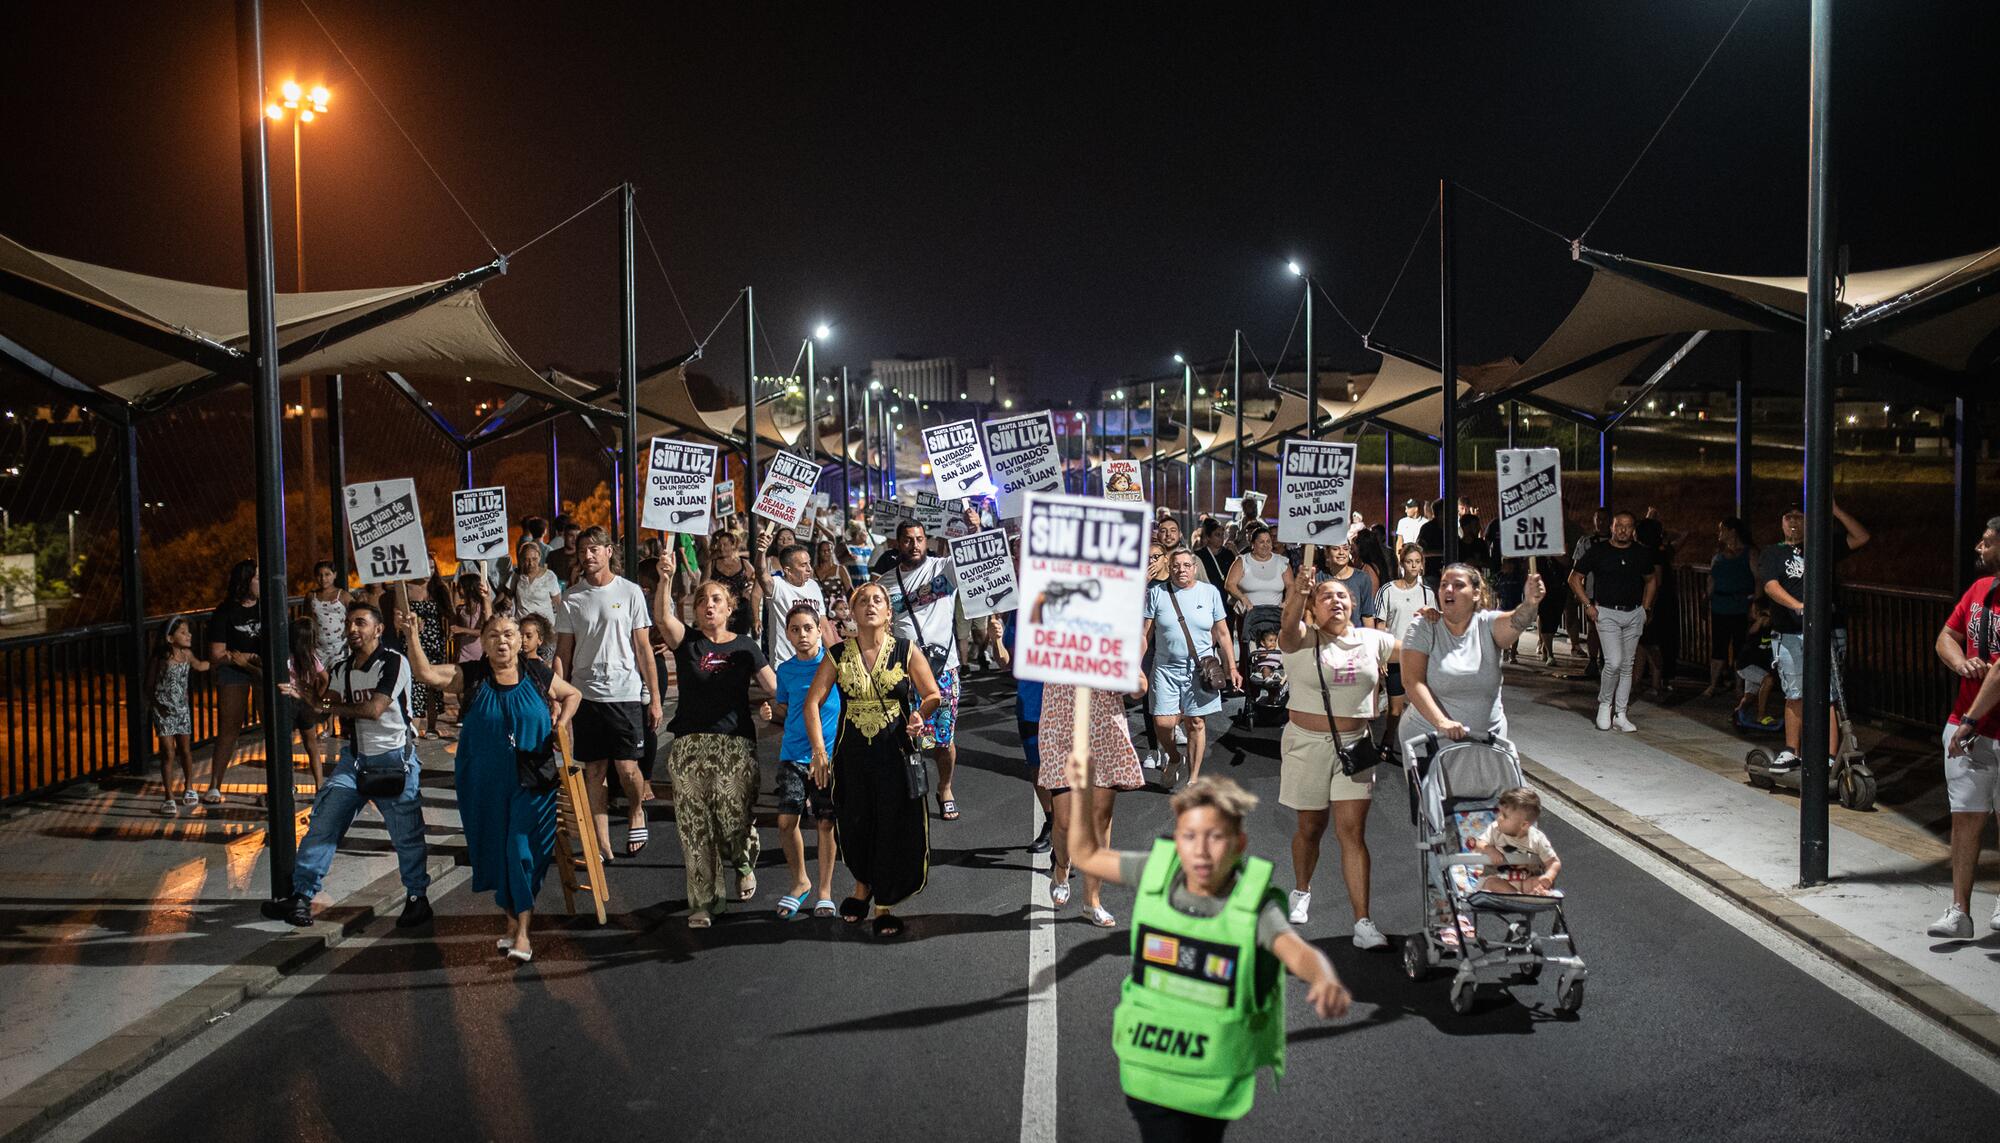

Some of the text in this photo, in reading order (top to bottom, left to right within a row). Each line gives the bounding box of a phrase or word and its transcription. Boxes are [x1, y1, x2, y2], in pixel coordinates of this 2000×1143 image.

[998, 418, 1039, 431] SANTA ISABEL
[928, 428, 974, 452] SIN LUZ
[990, 424, 1050, 452] SIN LUZ
[685, 446, 704, 454] ISABEL
[934, 444, 974, 466] OLVIDADOS
[996, 445, 1049, 471] OLVIDADOS
[654, 449, 711, 474] SIN LUZ
[774, 459, 816, 484] SIN LUZ
[941, 460, 982, 482] SAN JUAN!
[1288, 452, 1350, 476] SIN LUZ
[652, 475, 706, 485] OLVIDADOS
[1004, 466, 1057, 493] SAN JUAN!
[1287, 478, 1344, 493] OLVIDADOS
[1502, 473, 1549, 503] San Juan de
[457, 495, 502, 513] SIN LUZ
[654, 496, 706, 506] SAN JUAN!
[762, 497, 784, 511] DEJAD
[786, 506, 796, 514] DE
[917, 495, 945, 508] SIN LUZ
[949, 502, 961, 512] SIN
[1289, 501, 1345, 517] SAN JUAN!
[1504, 483, 1555, 517] Aznalfarache
[352, 502, 405, 534] San Juan de
[458, 511, 499, 527] OLVIDADOS
[757, 502, 795, 522] MATARNOS!
[356, 511, 414, 547] Aznalfarache
[462, 526, 504, 543] SAN JUAN!
[1517, 517, 1544, 534] SIN
[955, 538, 1005, 563] SIN LUZ
[1031, 516, 1140, 564] SIN LUZ
[1514, 533, 1548, 550] LUZ
[372, 544, 406, 561] SIN
[370, 559, 411, 577] LUZ
[960, 556, 1004, 580] OLVIDADOS
[1032, 560, 1046, 570] LA
[1051, 560, 1072, 573] LUZ
[1077, 562, 1091, 576] ES
[967, 574, 1011, 598] SAN JUAN!
[1034, 629, 1123, 656] DEJAD DE
[1026, 649, 1129, 678] MATARNOS!
[1334, 660, 1356, 684] LA
